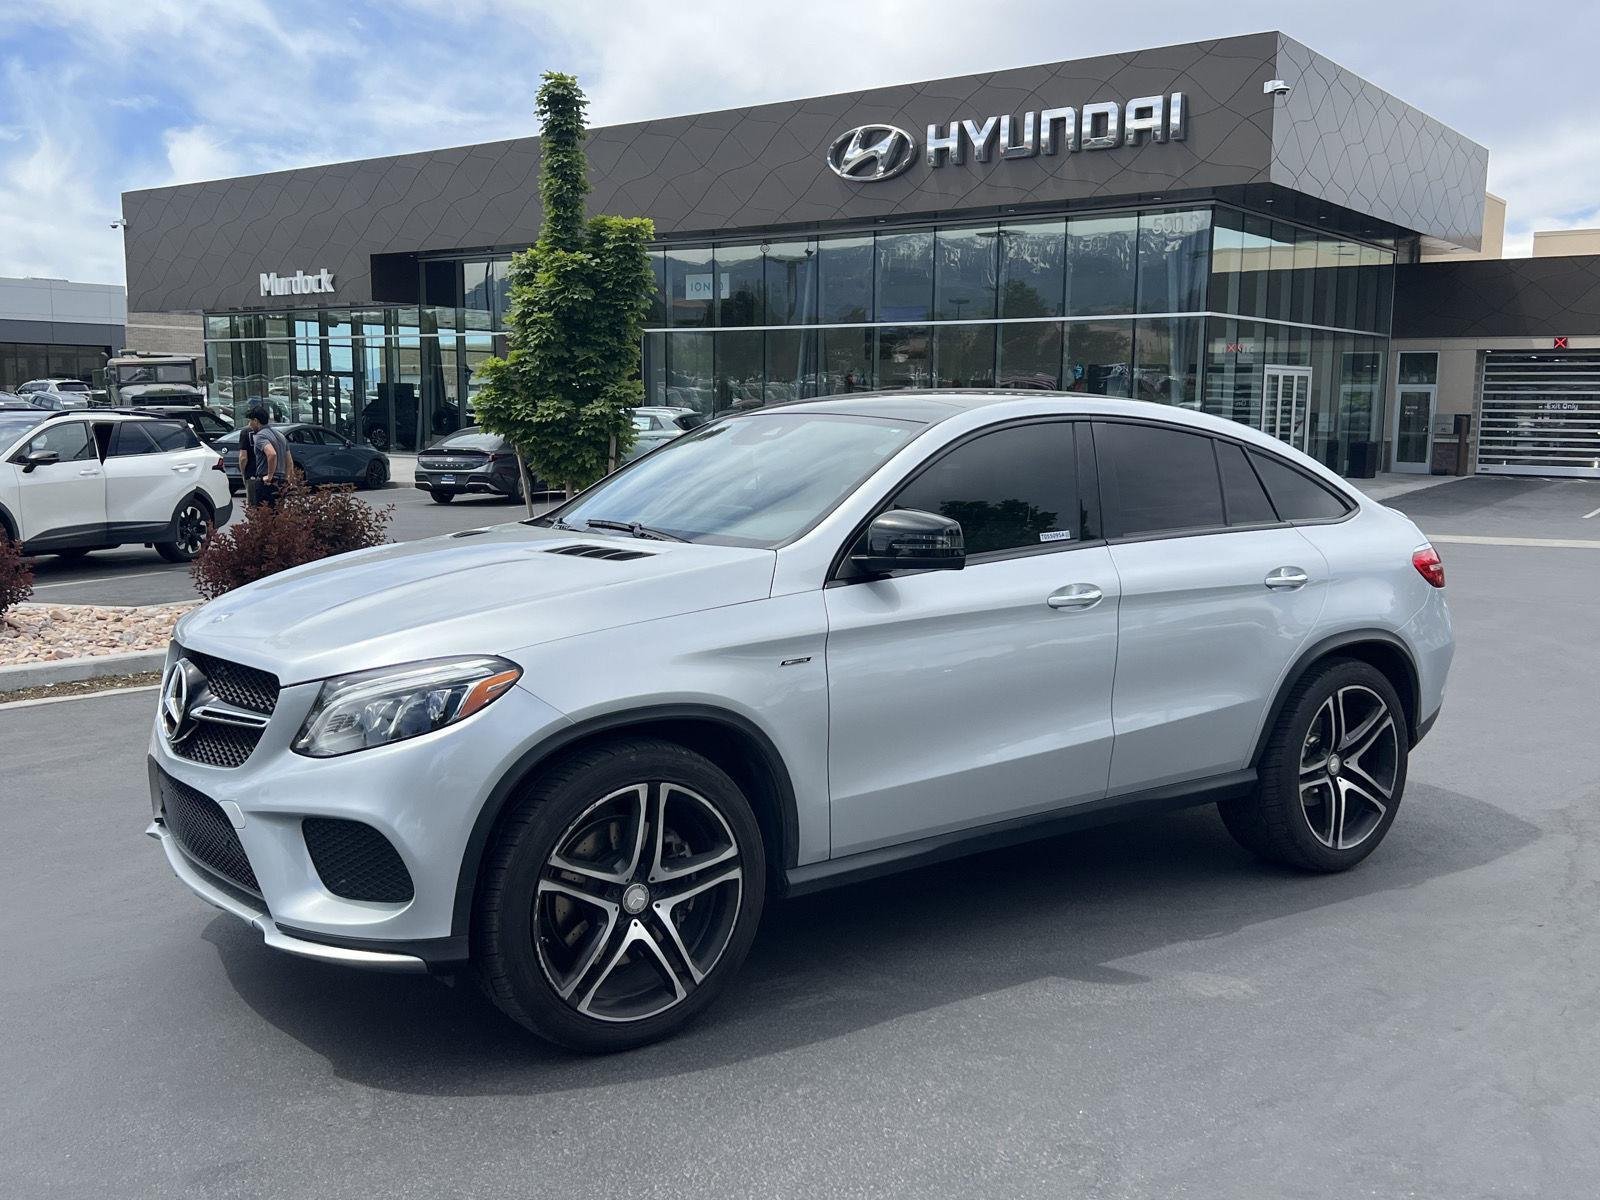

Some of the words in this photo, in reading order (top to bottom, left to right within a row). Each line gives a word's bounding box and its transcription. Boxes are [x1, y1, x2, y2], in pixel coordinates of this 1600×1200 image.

[926, 92, 1188, 168] HYUNDAI
[259, 268, 335, 297] Murdock
[1562, 402, 1579, 410] Only
